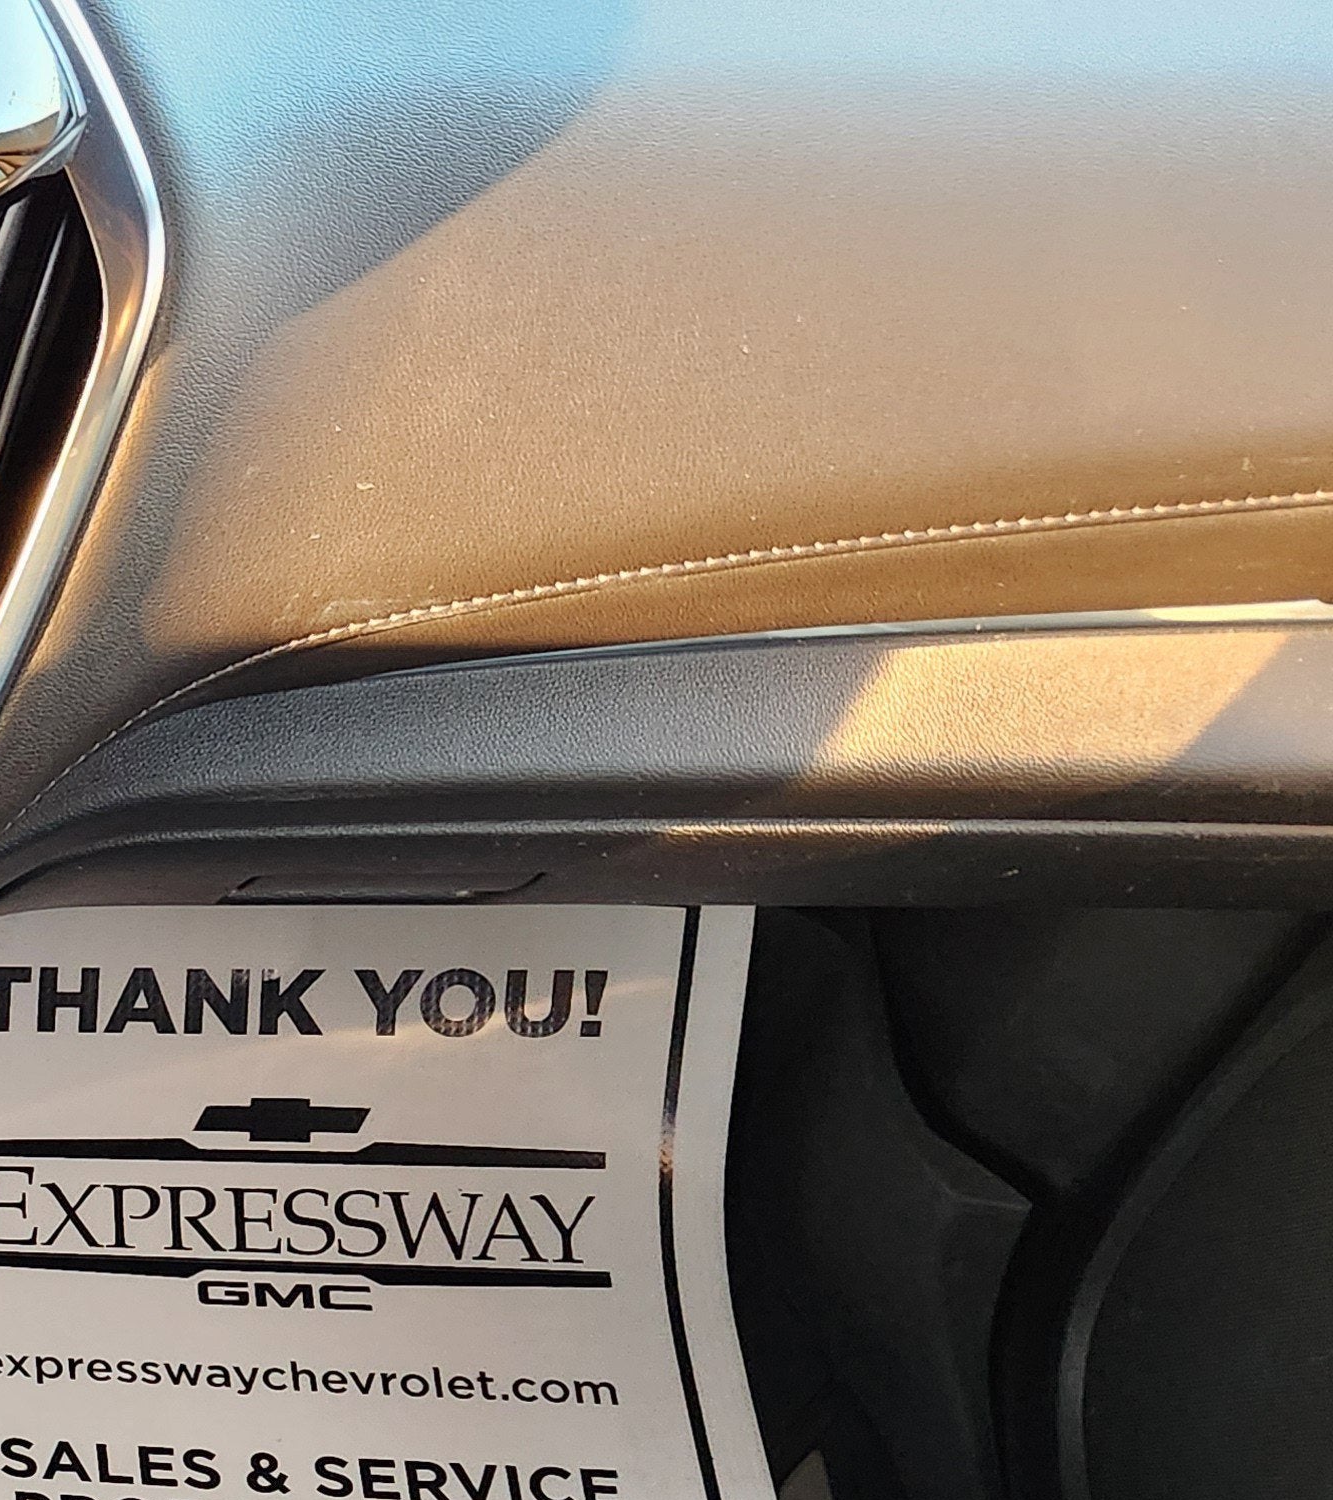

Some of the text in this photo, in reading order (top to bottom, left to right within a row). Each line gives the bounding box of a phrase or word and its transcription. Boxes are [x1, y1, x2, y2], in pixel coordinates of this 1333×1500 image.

[357, 968, 609, 1039] YOU!
[197, 1279, 374, 1311] GMC
[0, 1437, 222, 1491] SALES
[245, 1451, 291, 1495] &
